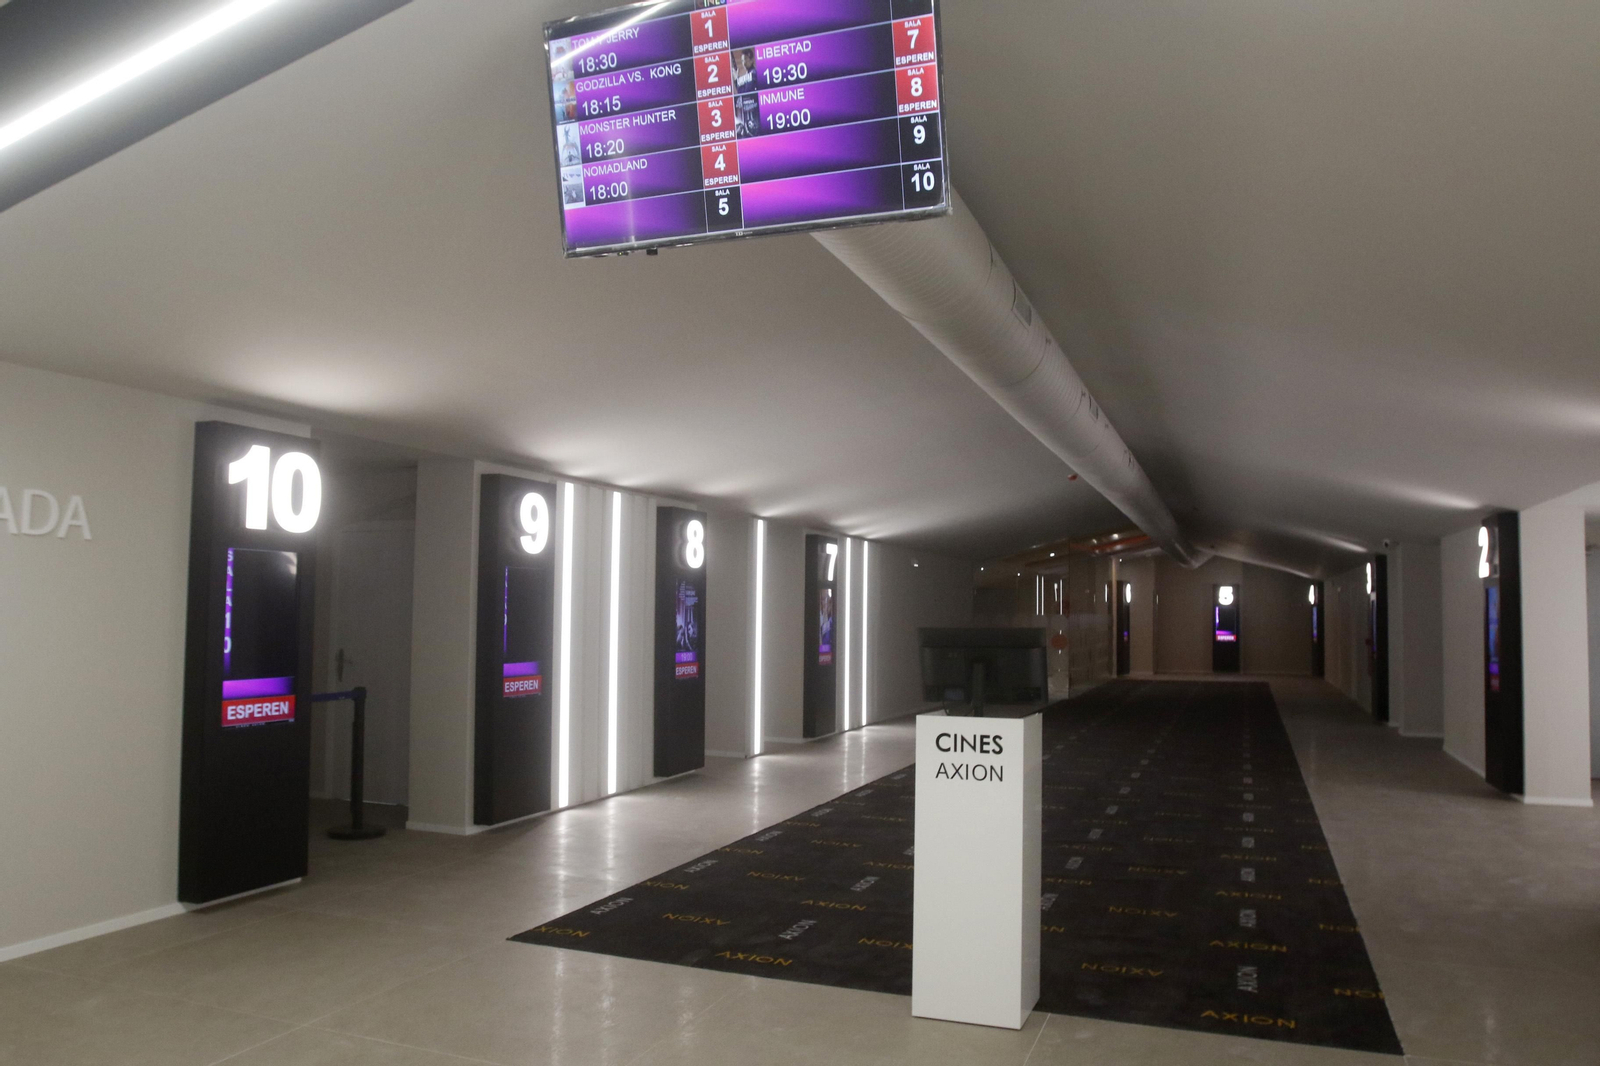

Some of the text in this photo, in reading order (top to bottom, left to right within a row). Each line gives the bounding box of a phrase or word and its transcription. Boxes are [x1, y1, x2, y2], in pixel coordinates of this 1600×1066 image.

[701, 10, 716, 19] SALA
[904, 19, 922, 28] SALA
[607, 27, 640, 44] JERRY
[704, 19, 714, 38] 1
[694, 40, 728, 54] ESPEREN
[907, 29, 920, 49] 7
[704, 54, 720, 63] SALA
[756, 40, 812, 60] LIBERTAD
[896, 51, 935, 66] ESPEREN
[578, 52, 618, 74] 18:30
[907, 67, 924, 76] SALA
[576, 63, 682, 93] GODZILLA VS. KONG
[707, 64, 719, 83] 2
[763, 62, 808, 85] 19:30
[698, 85, 732, 98] ESPEREN
[910, 77, 923, 97] 8
[708, 100, 723, 108] SALA
[760, 87, 805, 106] INMUNE
[582, 95, 621, 117] 18:15
[899, 99, 938, 113] ESPEREN
[579, 109, 677, 136] MONSTER HUNTER
[711, 109, 722, 128] 3
[766, 108, 811, 130] 19:00
[911, 115, 928, 124] SALA
[701, 130, 735, 143] ESPEREN
[913, 124, 926, 145] 9
[586, 138, 625, 159] 18:20
[711, 144, 727, 153] SALA
[584, 158, 648, 178] NOMADLAND
[714, 153, 726, 171] 4
[913, 162, 931, 171] SALA
[704, 174, 739, 187] ESPEREN
[911, 171, 935, 192] 10
[590, 181, 628, 200] 18:00
[715, 188, 730, 197] SALA
[718, 197, 729, 216] 5
[228, 444, 322, 534] 10
[0, 486, 92, 541] ADA
[519, 492, 550, 555] 9
[685, 519, 705, 569] 8
[1477, 526, 1490, 579] 2
[825, 543, 838, 582] 7
[1217, 585, 1235, 606] 5
[675, 666, 698, 676] ESPEREN
[504, 679, 539, 693] ESPEREN
[227, 701, 290, 720] ESPEREN
[935, 732, 1004, 755] CINES
[935, 762, 1004, 782] AXION
[637, 880, 690, 891] XION
[1044, 877, 1092, 886] XION
[800, 899, 867, 911] AXION
[1108, 905, 1179, 918] AXION
[661, 913, 731, 926] AXION
[532, 925, 591, 938] XION
[858, 937, 914, 950] XION
[1209, 940, 1288, 953] AXION
[715, 951, 793, 967] AXION
[1081, 962, 1165, 977] AXION
[1333, 987, 1385, 1000] ION
[1200, 1010, 1297, 1030] AXION
